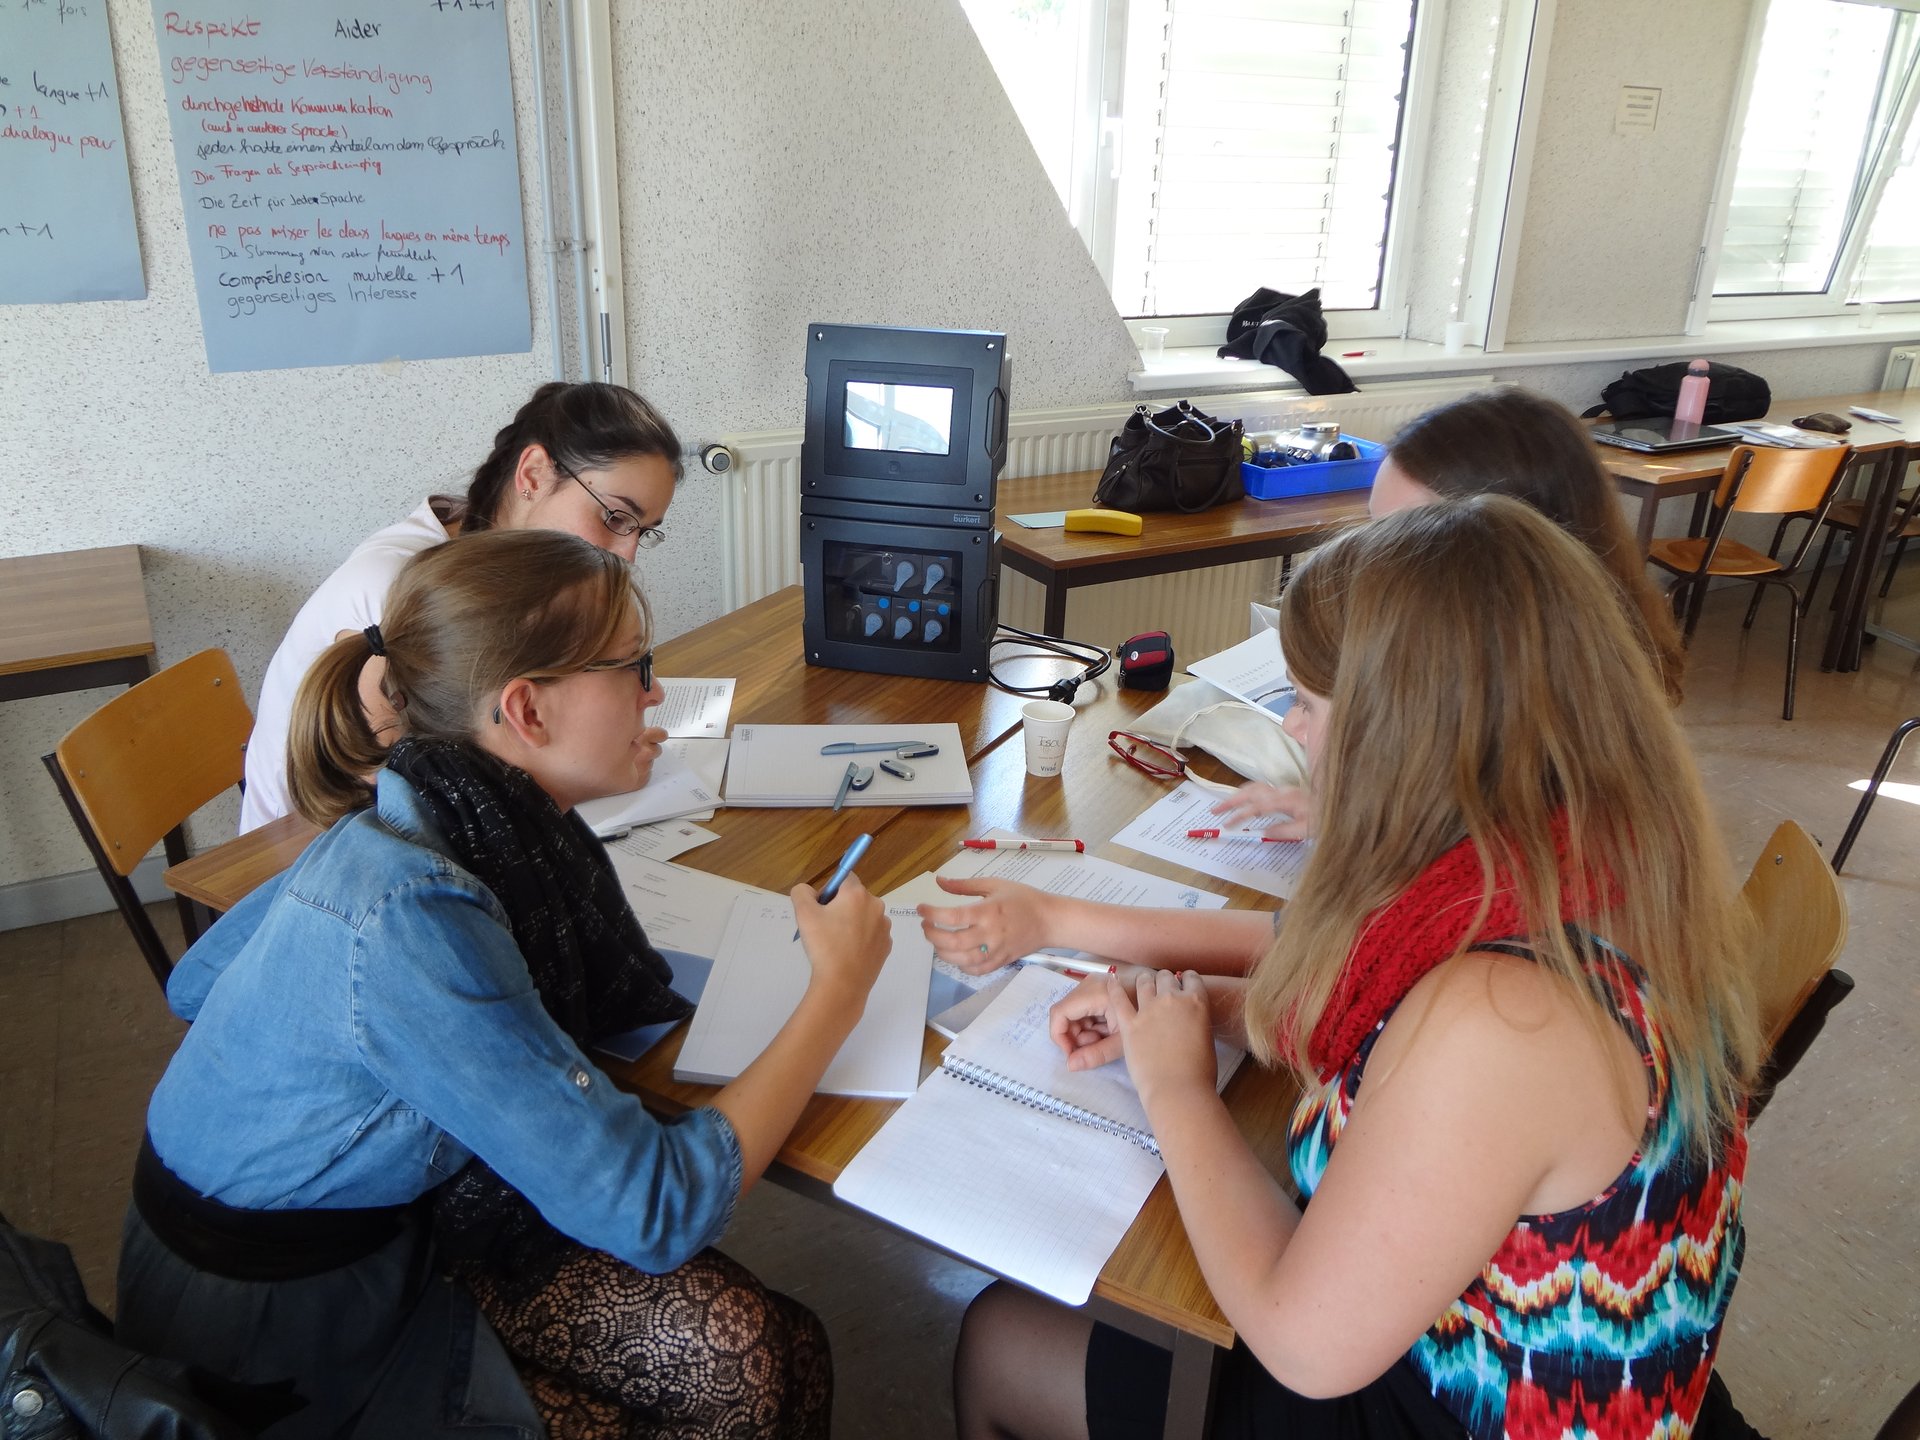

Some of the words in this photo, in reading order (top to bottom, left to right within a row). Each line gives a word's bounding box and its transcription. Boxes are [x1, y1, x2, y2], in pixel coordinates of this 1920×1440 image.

[164, 11, 262, 48] Respekt
[334, 17, 382, 39] Aider
[170, 55, 297, 84] gegenseitige
[33, 70, 80, 105] langue
[191, 170, 216, 185] Die
[215, 163, 261, 183] Fragen
[266, 162, 283, 175] als
[199, 196, 226, 209] Die
[231, 193, 262, 208] Zeit
[208, 223, 228, 239] ne
[238, 225, 262, 248] pas
[271, 224, 310, 241] mixer
[317, 218, 332, 239] les
[474, 223, 511, 256] temps
[227, 286, 337, 318] gegenseitiges
[347, 283, 417, 303] Interesse
